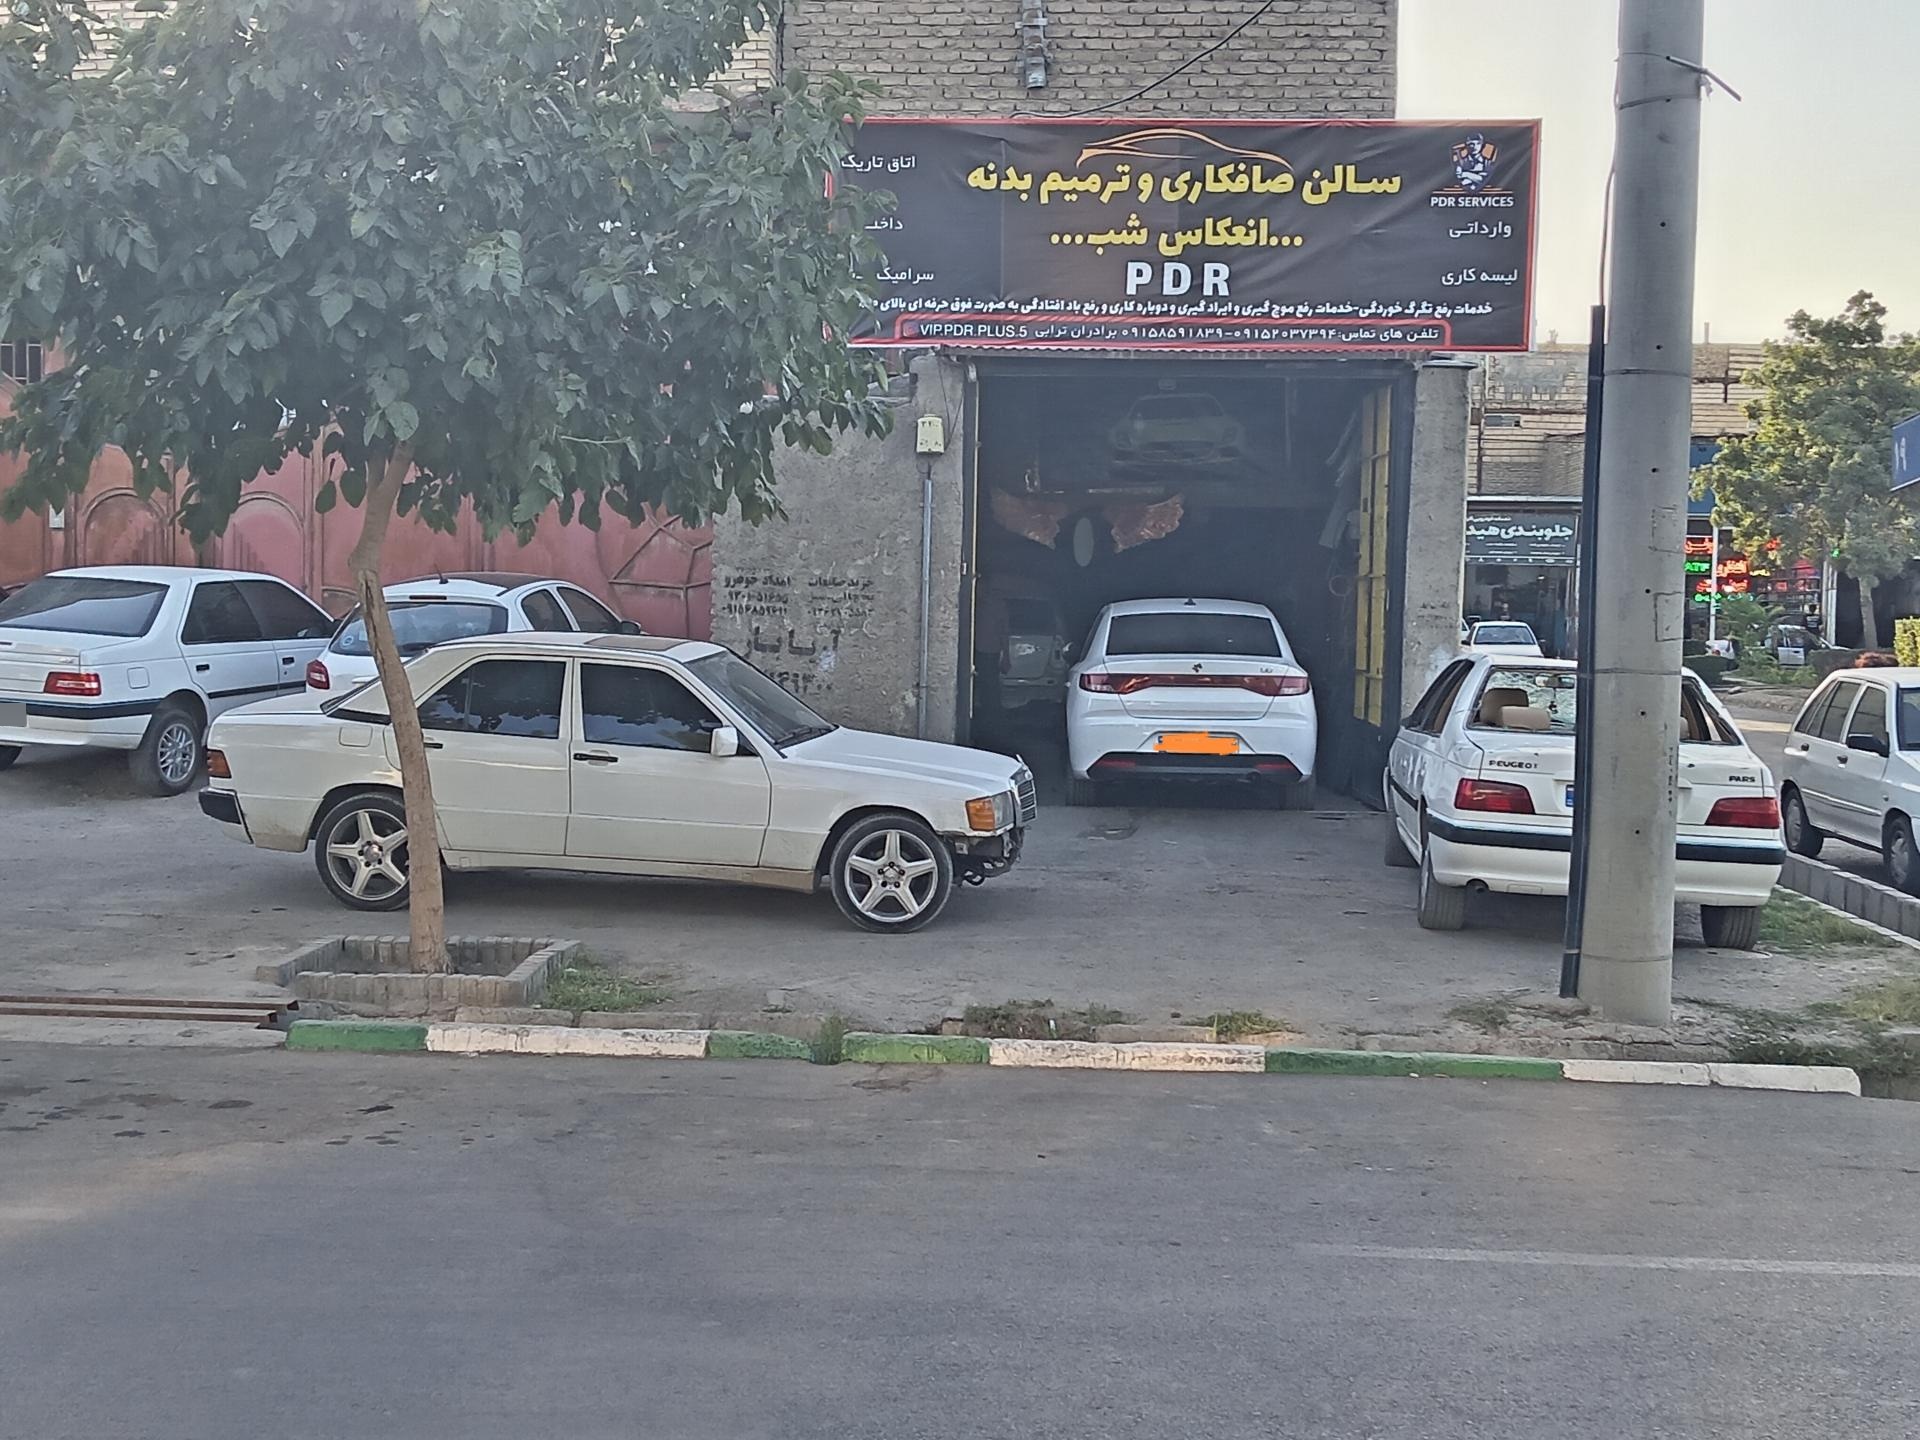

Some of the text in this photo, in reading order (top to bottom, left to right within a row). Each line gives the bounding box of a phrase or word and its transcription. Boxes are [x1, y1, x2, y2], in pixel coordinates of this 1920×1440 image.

[841, 154, 916, 173] اتاق تاریک
[967, 162, 1402, 206] سالن صافکاری و ترمیم بدنه
[1431, 196, 1514, 208] PDR SERVICES
[1449, 220, 1512, 239] وارداتی
[876, 267, 935, 285] سرامیک
[1441, 268, 1518, 286] لیسه کاری
[880, 297, 906, 312] بالای
[908, 298, 922, 312] ای
[925, 298, 949, 312] حرفه
[951, 297, 972, 312] فوق
[974, 299, 1006, 313] صورت
[1008, 300, 1018, 313] به
[1021, 298, 1064, 313] افتادگی
[1066, 300, 1081, 315] باد
[1082, 300, 1100, 315] رفع
[1109, 300, 1135, 315] کاری
[1136, 301, 1168, 315] دوباره
[1178, 299, 1206, 315] گیری
[1208, 301, 1232, 316] ایراد
[1242, 300, 1270, 316] گیری
[1271, 303, 1295, 319] موج
[1295, 302, 1313, 318] رفع
[1404, 301, 1433, 318] تگرگ
[1434, 303, 1452, 319] رفع
[1453, 301, 1493, 315] خدمات
[920, 324, 1028, 337] VIP.PDR.PLUS.5
[1034, 325, 1067, 337] ترابی
[1070, 325, 1117, 339] برادران
[1379, 328, 1403, 341] های
[1406, 328, 1439, 341] تلفن
[1499, 524, 1573, 541] جلوبندی
[1489, 760, 1538, 769] PEUGEOT
